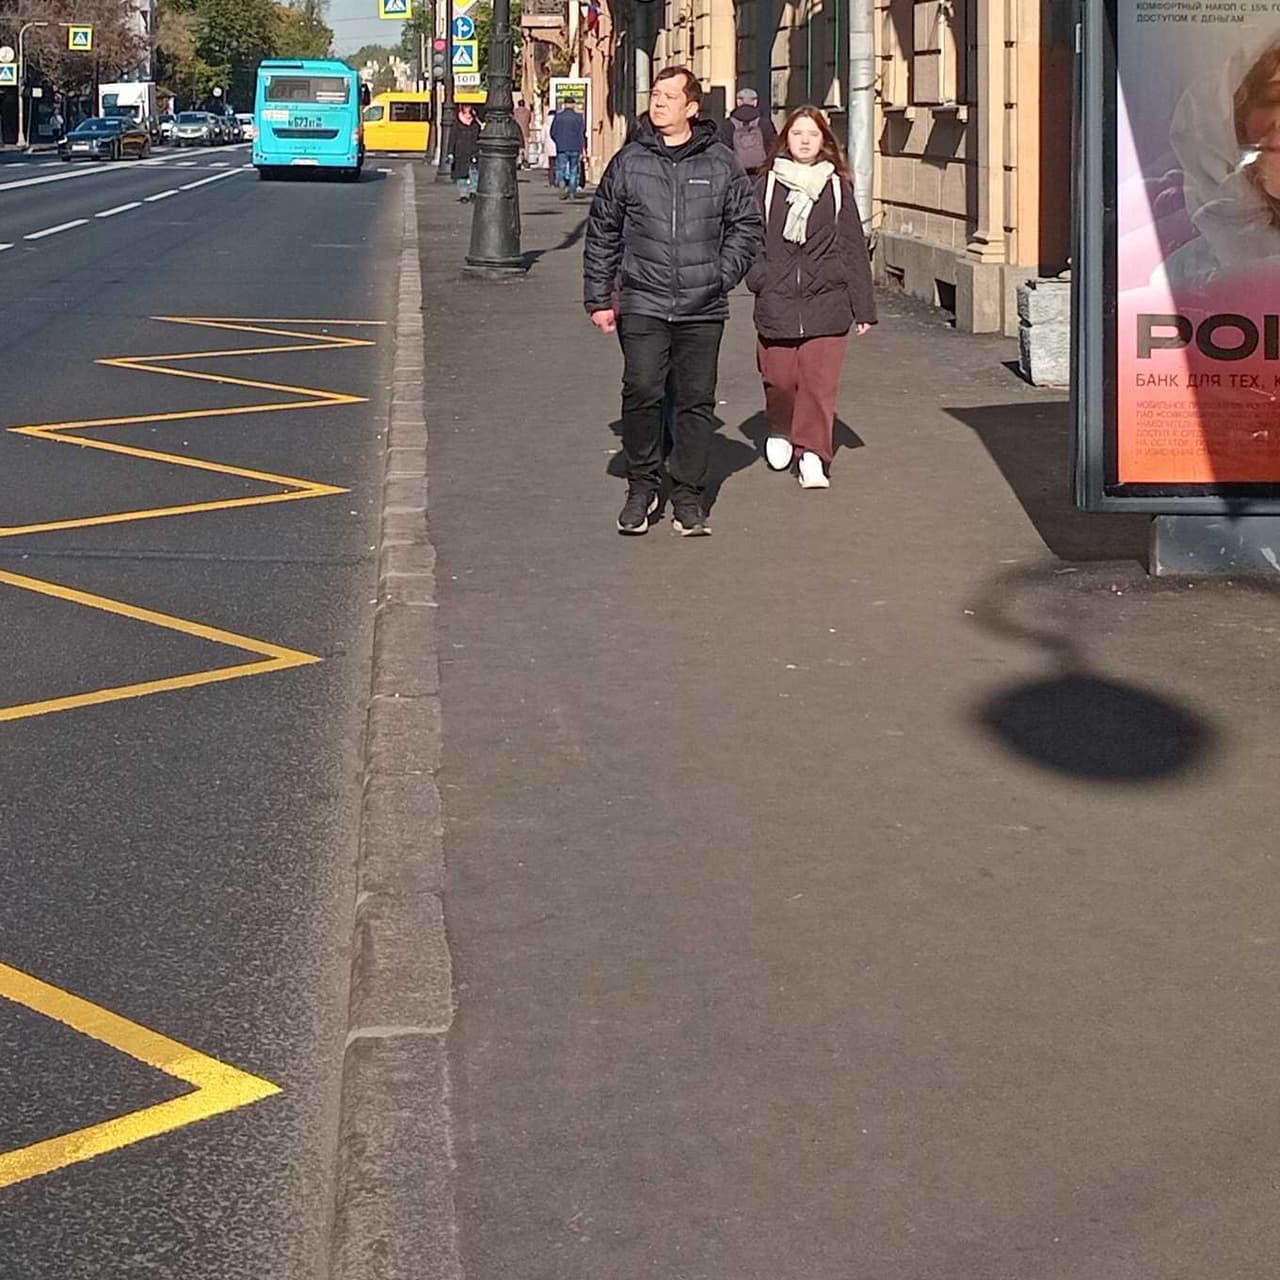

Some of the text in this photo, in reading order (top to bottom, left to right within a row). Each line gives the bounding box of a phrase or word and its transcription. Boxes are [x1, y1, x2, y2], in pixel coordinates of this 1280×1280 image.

[1136, 1, 1202, 11] КОМФОРТНЫЙ
[1205, 2, 1237, 11] НАКОП
[1240, 3, 1247, 11] С
[1251, 3, 1268, 12] 15%
[1137, 14, 1245, 23] ДОСТУПОМ К ДЕНЬГАМ
[1136, 374, 1178, 387] БАНК
[1187, 374, 1221, 388] ДЛЯ
[1230, 374, 1264, 389] ТЕХ,
